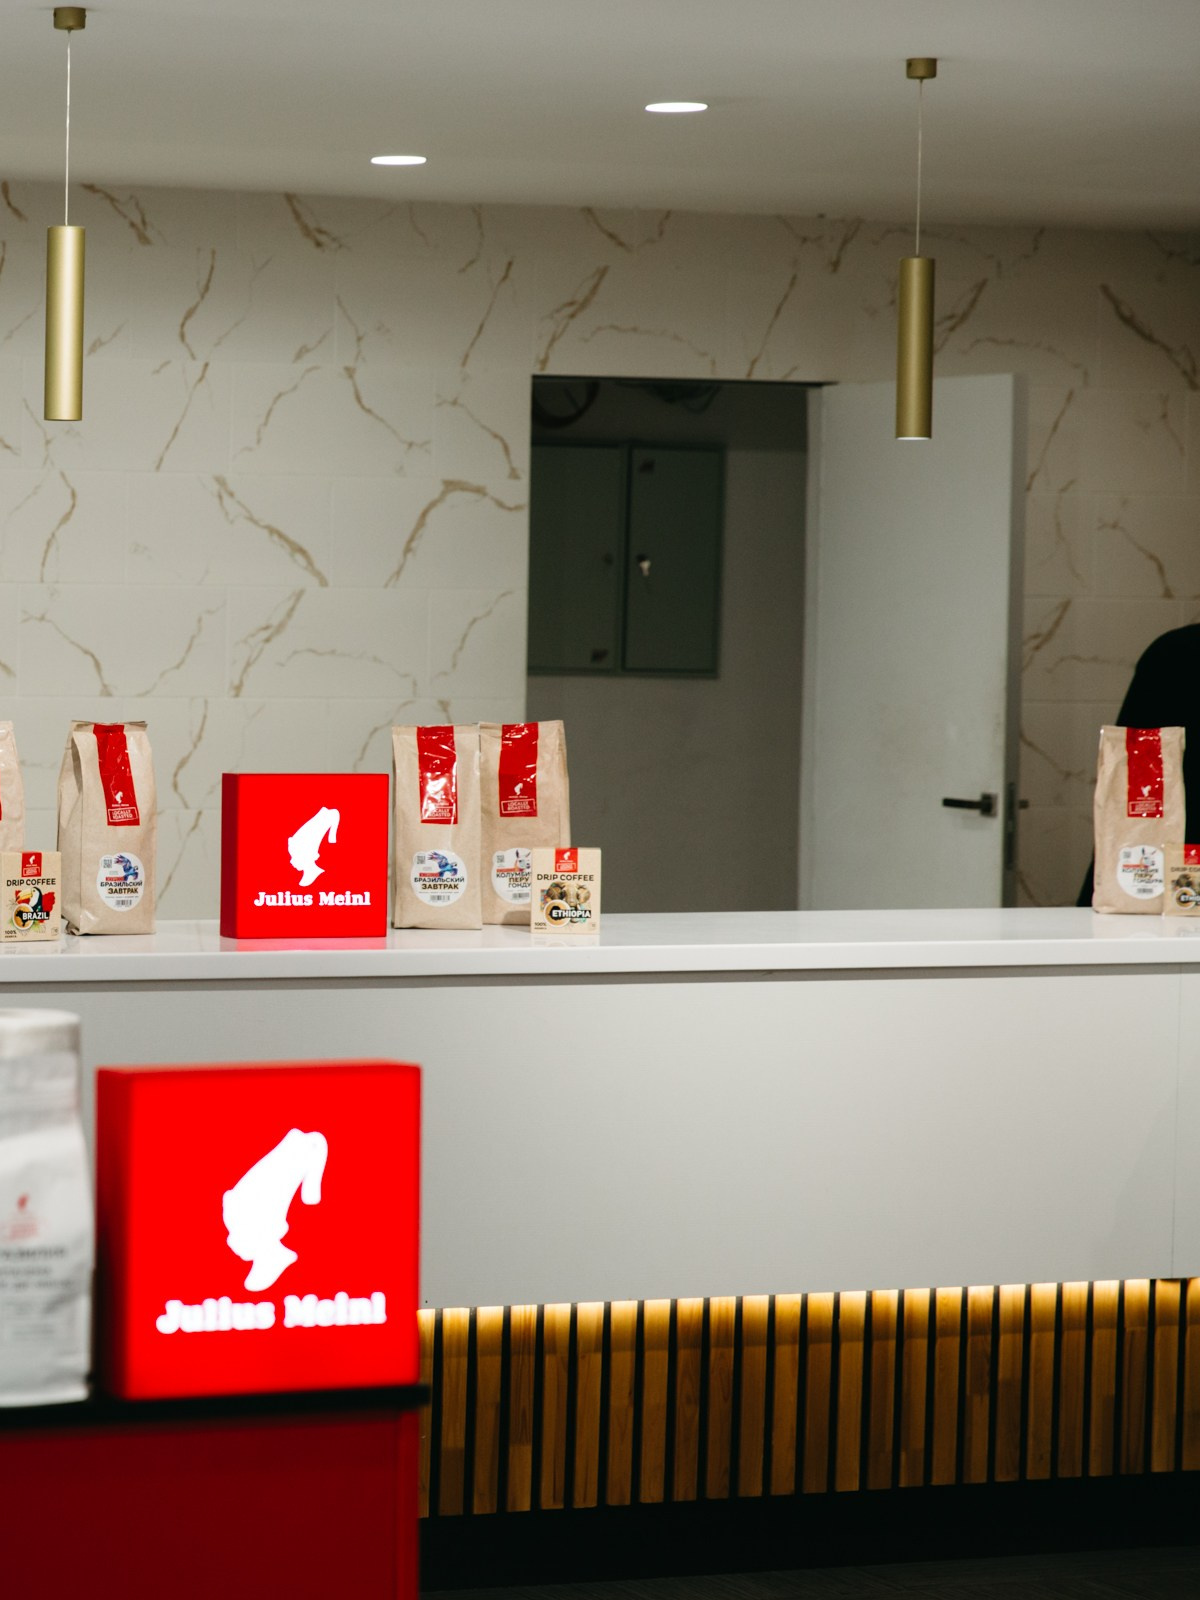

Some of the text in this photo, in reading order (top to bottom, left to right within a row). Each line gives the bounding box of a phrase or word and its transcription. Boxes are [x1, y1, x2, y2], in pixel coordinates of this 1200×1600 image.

[6, 878, 56, 887] DRIP COFFEE
[108, 887, 139, 895] ЗАВТРАК
[254, 891, 371, 906] Julius Meinl
[22, 912, 49, 920] BRAZIL
[551, 909, 591, 918] ETHIOPIA
[155, 1291, 387, 1334] Julius Meinl
